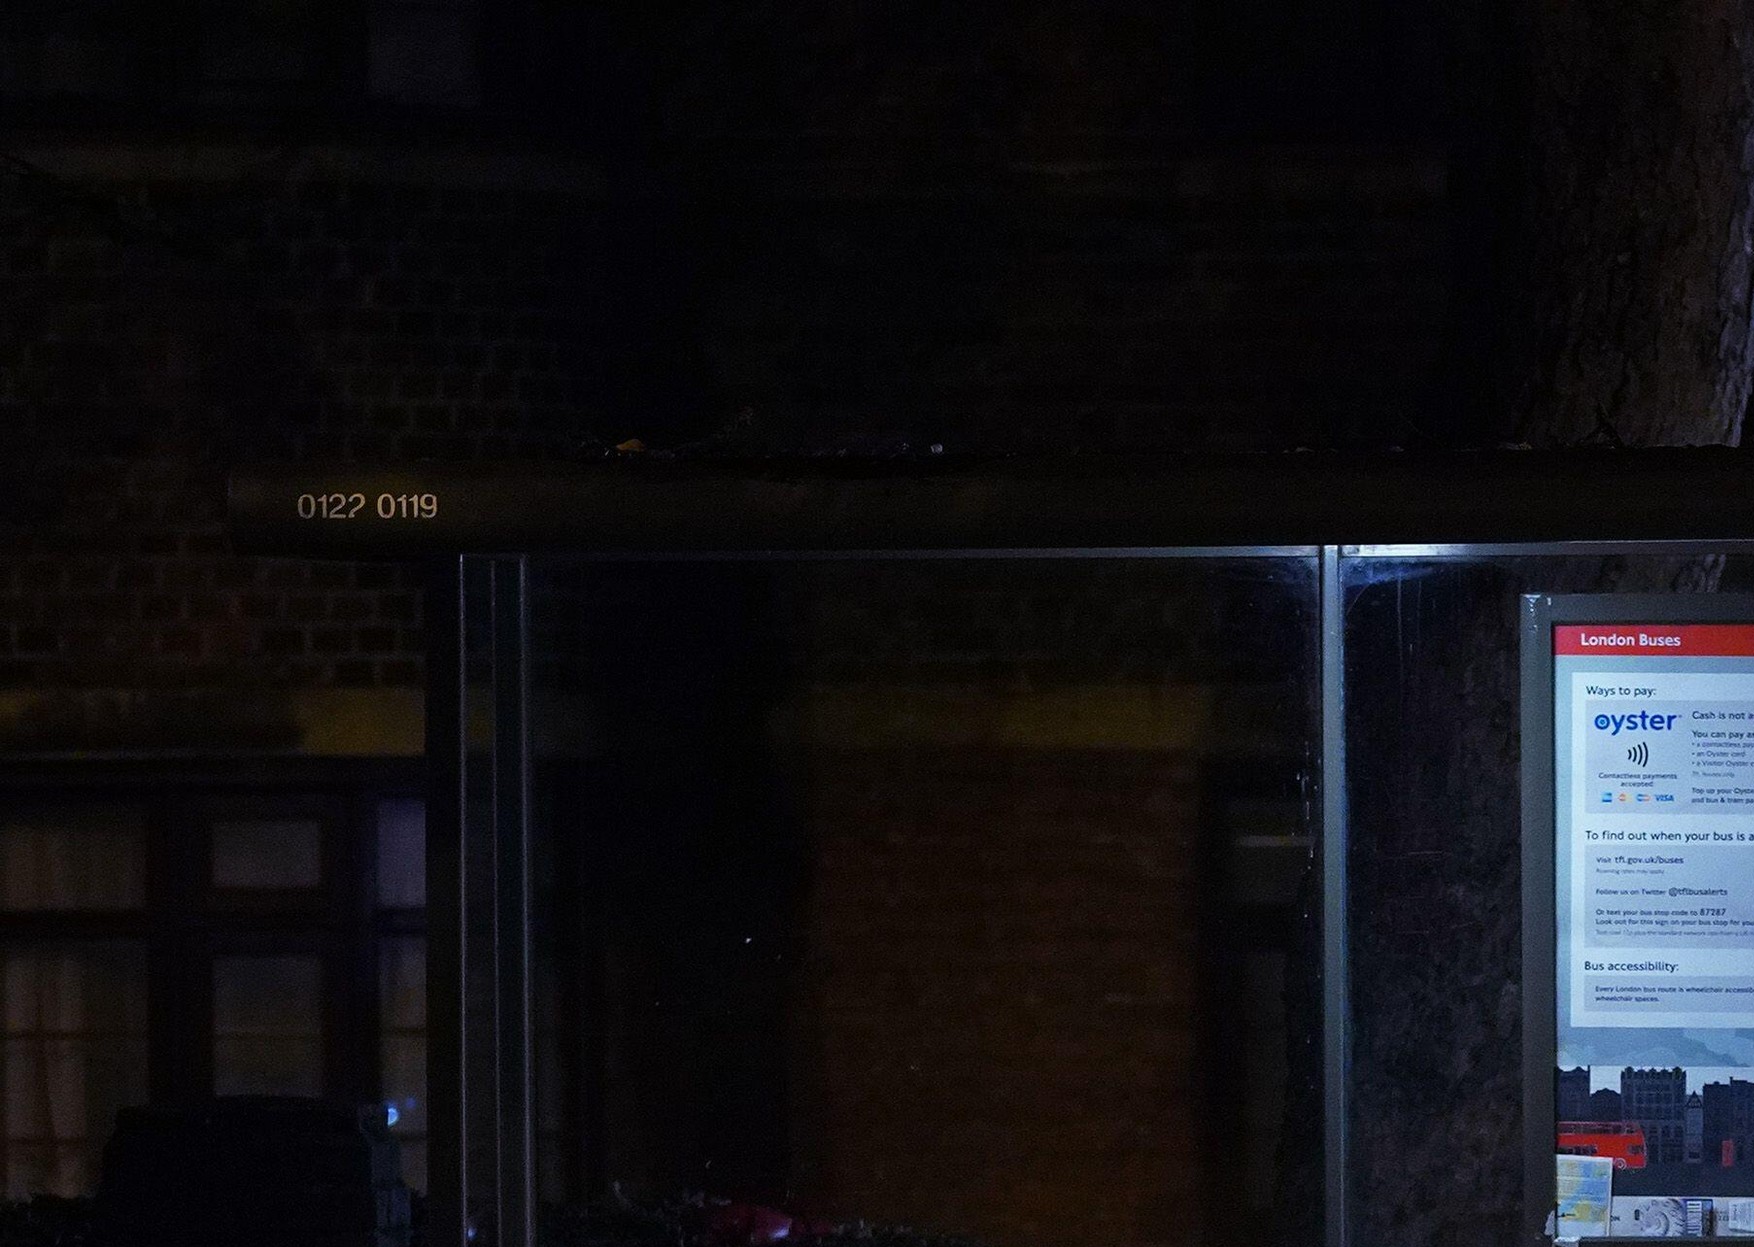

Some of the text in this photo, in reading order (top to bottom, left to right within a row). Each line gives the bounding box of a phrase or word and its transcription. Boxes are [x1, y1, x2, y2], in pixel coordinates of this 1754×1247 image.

[377, 493, 437, 519] 0119
[1581, 633, 1681, 647] London Buses
[1586, 686, 1656, 698] Ways to pay:
[1692, 710, 1716, 720] Cash
[1718, 711, 1726, 720] is
[1728, 712, 1746, 720] not
[1594, 710, 1677, 736] oyster
[1692, 730, 1708, 738] You
[1729, 732, 1744, 740] pay
[1725, 760, 1748, 768] Oyster
[1598, 772, 1677, 780] Contactless payments
[1585, 830, 1599, 841] To
[1602, 830, 1624, 841] find
[1628, 832, 1647, 841] out
[1651, 831, 1681, 841] when
[1685, 832, 1709, 843] your
[1713, 831, 1733, 841] bus
[1737, 831, 1746, 841] is
[1615, 856, 1684, 865] tfl.gov.uk/buses
[1584, 961, 1679, 973] Bus accessibility:
